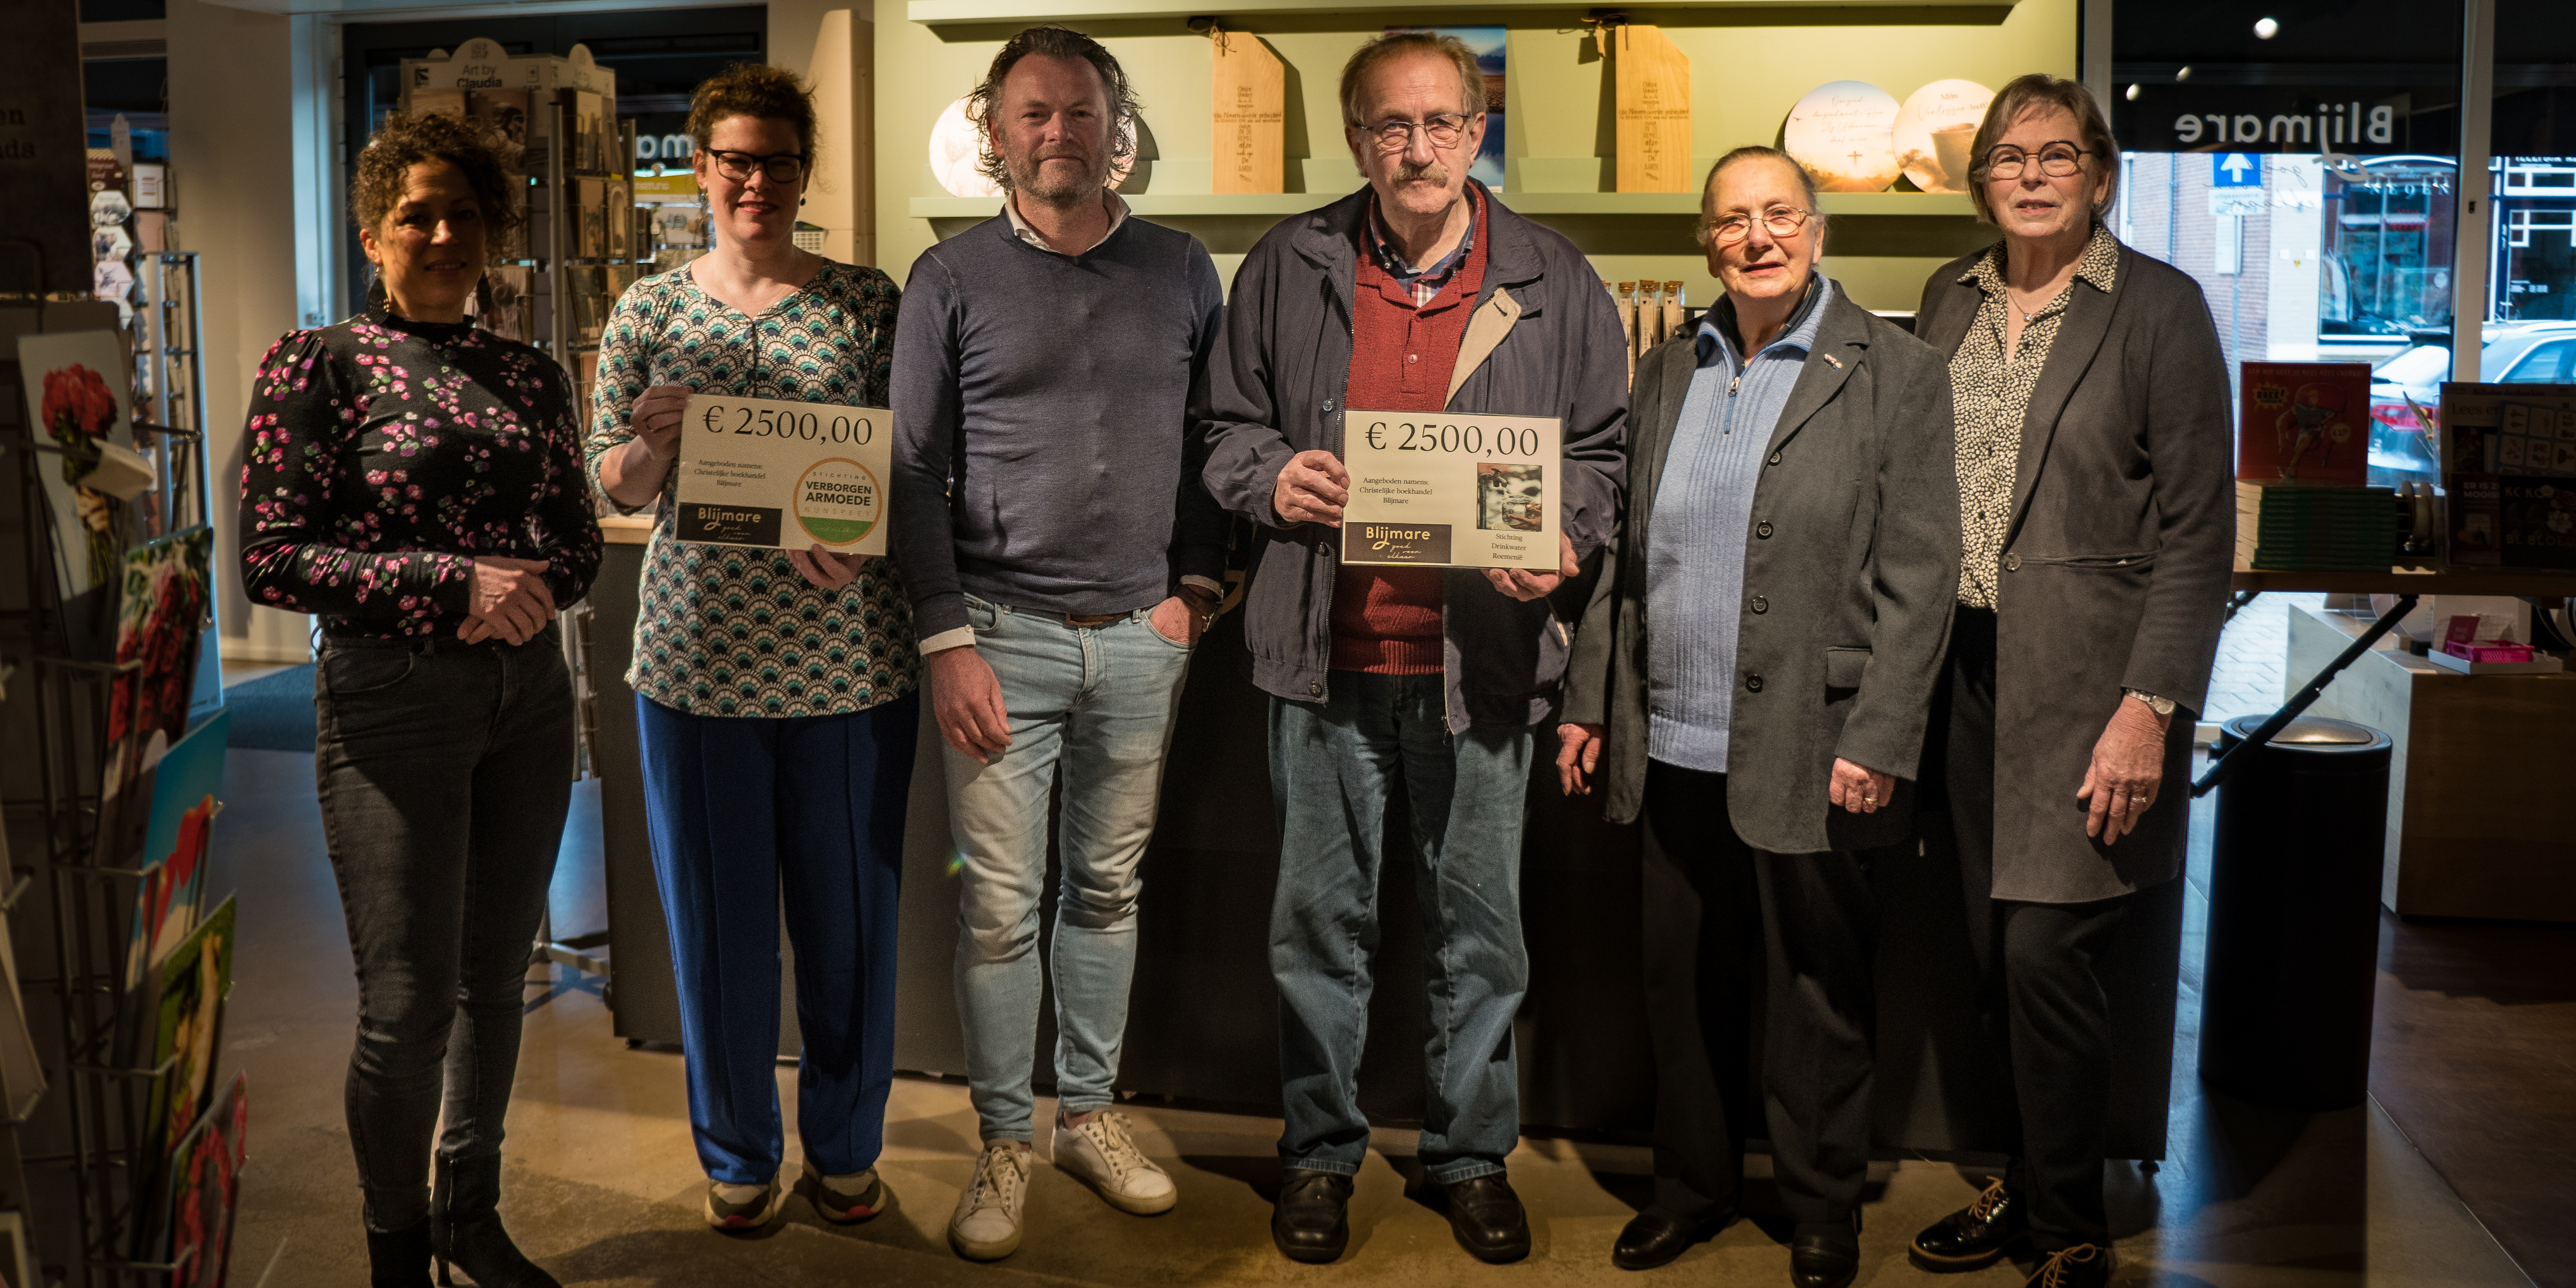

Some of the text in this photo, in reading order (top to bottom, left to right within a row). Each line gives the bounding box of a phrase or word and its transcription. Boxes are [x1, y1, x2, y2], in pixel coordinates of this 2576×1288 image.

[463, 65, 496, 77] Art by
[457, 77, 502, 89] Claudia
[2451, 403, 2483, 415] Lees
[702, 406, 872, 445] € 2500,00
[1365, 422, 1538, 458] € 2500,00
[698, 459, 736, 468] Aangeboden
[694, 468, 766, 479] Christelijke boekhandel
[812, 471, 866, 480] STICHTING
[806, 481, 872, 494] VERBORGEN
[805, 491, 871, 506] ARMOEDE
[804, 507, 871, 517] NUNSPEET
[698, 507, 761, 531] Blijmare
[1366, 526, 1430, 550] Blijmare
[1495, 533, 1523, 542] Stichting
[1390, 542, 1411, 552] goed
[1492, 543, 1526, 551] Drinkwater
